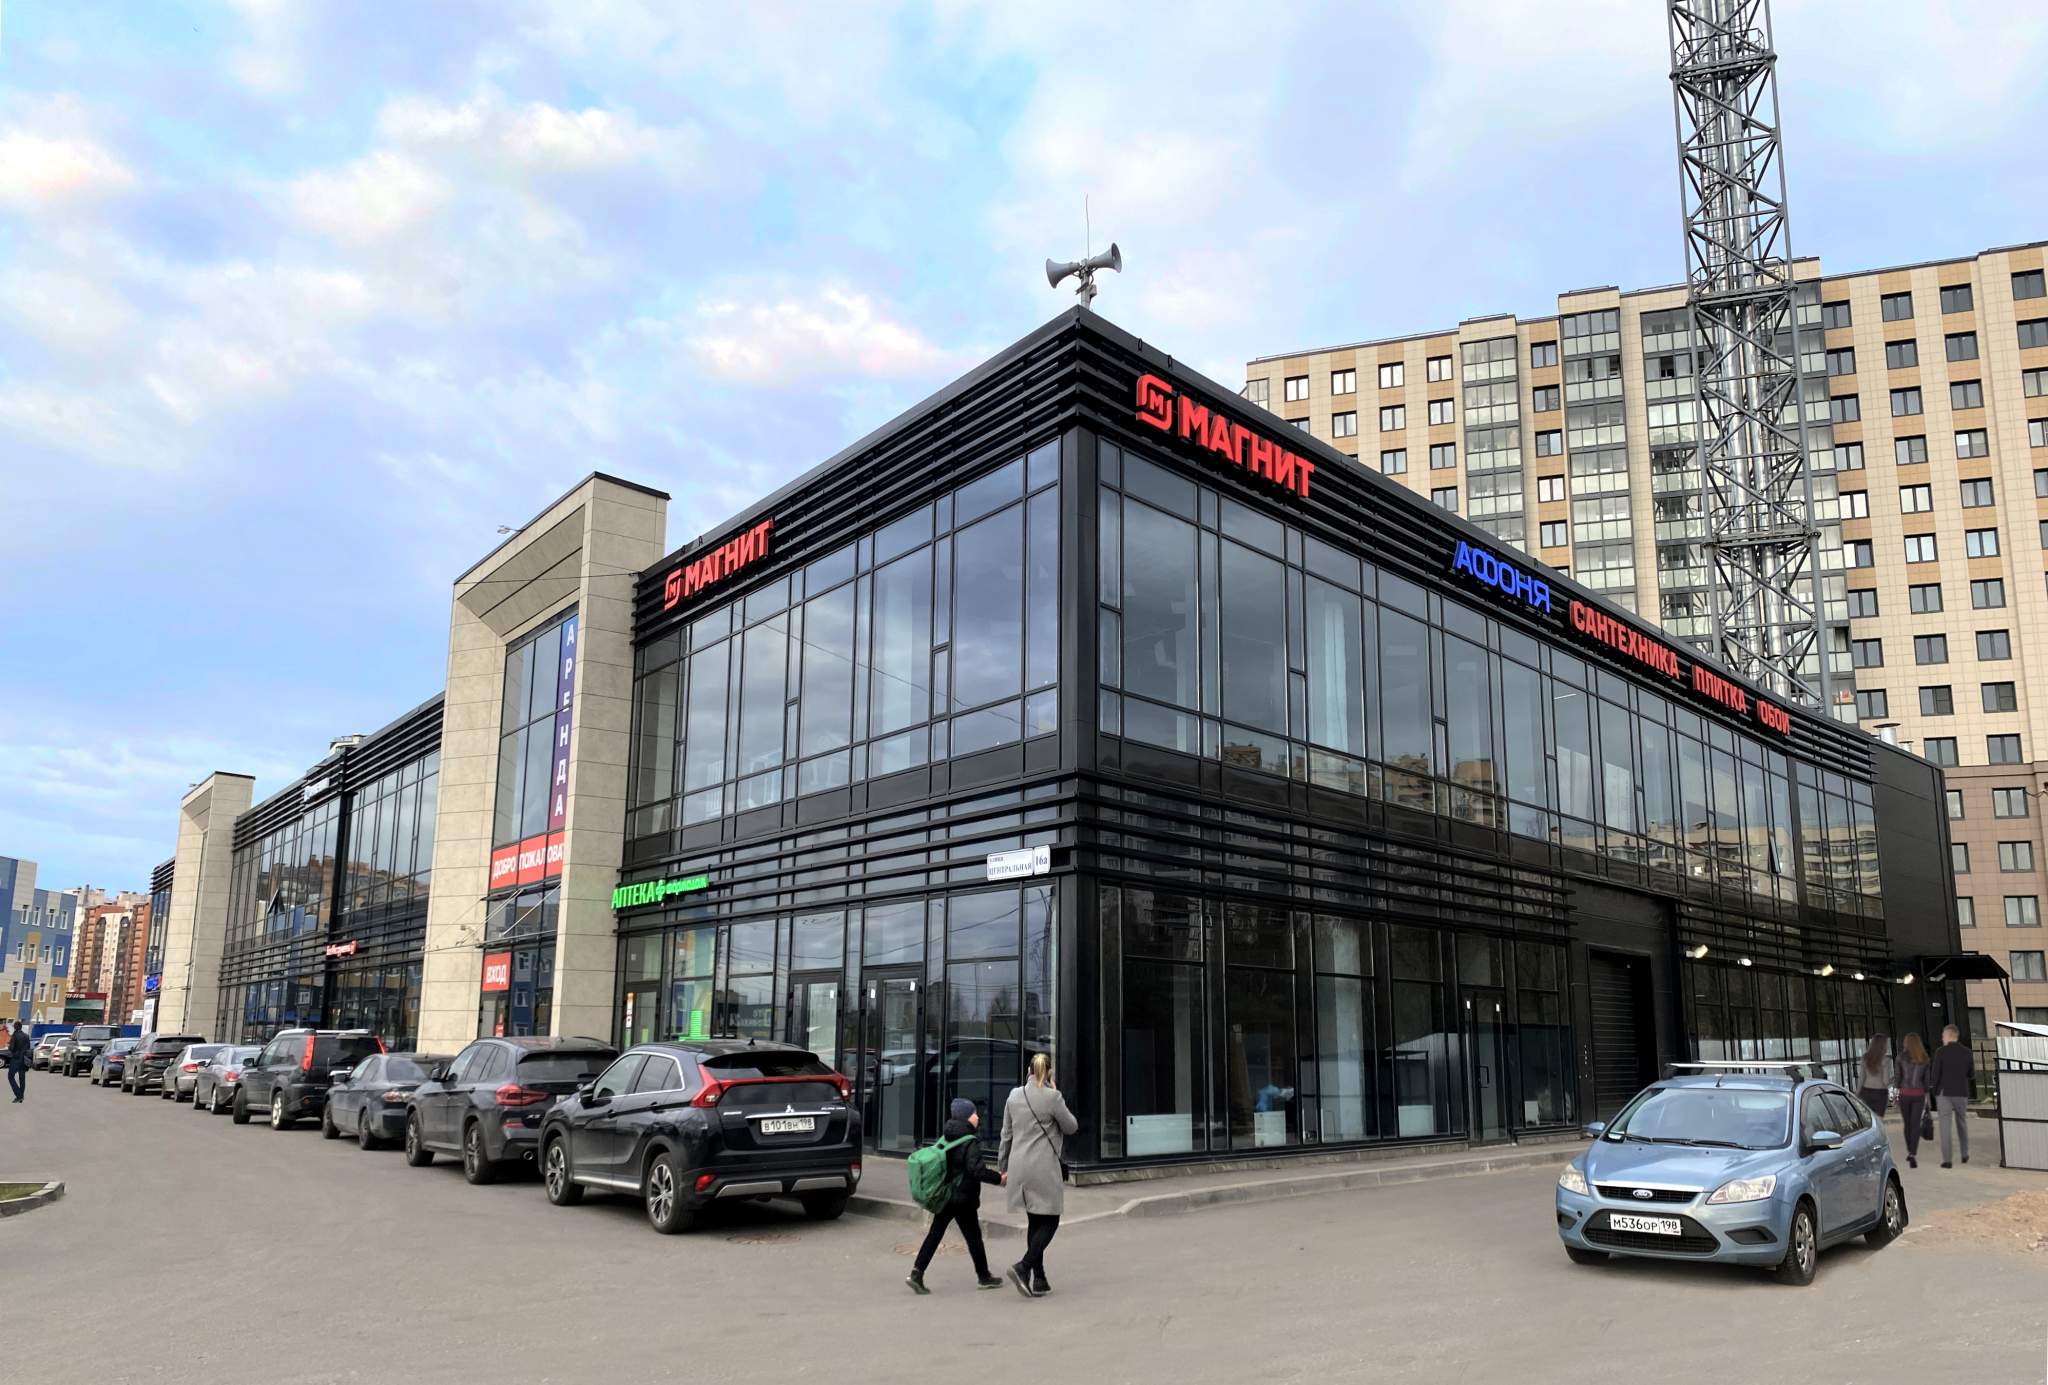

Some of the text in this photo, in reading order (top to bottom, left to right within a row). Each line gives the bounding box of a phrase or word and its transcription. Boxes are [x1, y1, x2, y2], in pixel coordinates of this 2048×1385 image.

[1177, 394, 1315, 497] МАГНИТ
[684, 518, 774, 597] МАГНИТ
[1454, 540, 1550, 614] АФОНЯ
[1569, 600, 1791, 736] САНТЕХНИКА ПЛИТКА ОБОИ
[554, 623, 575, 816] АРЕНДА
[492, 855, 517, 880] ДОБРО
[611, 881, 656, 909] АПТЕКА
[486, 965, 507, 985] ВХОД
[1613, 1217, 1677, 1231] М536ОР 198
